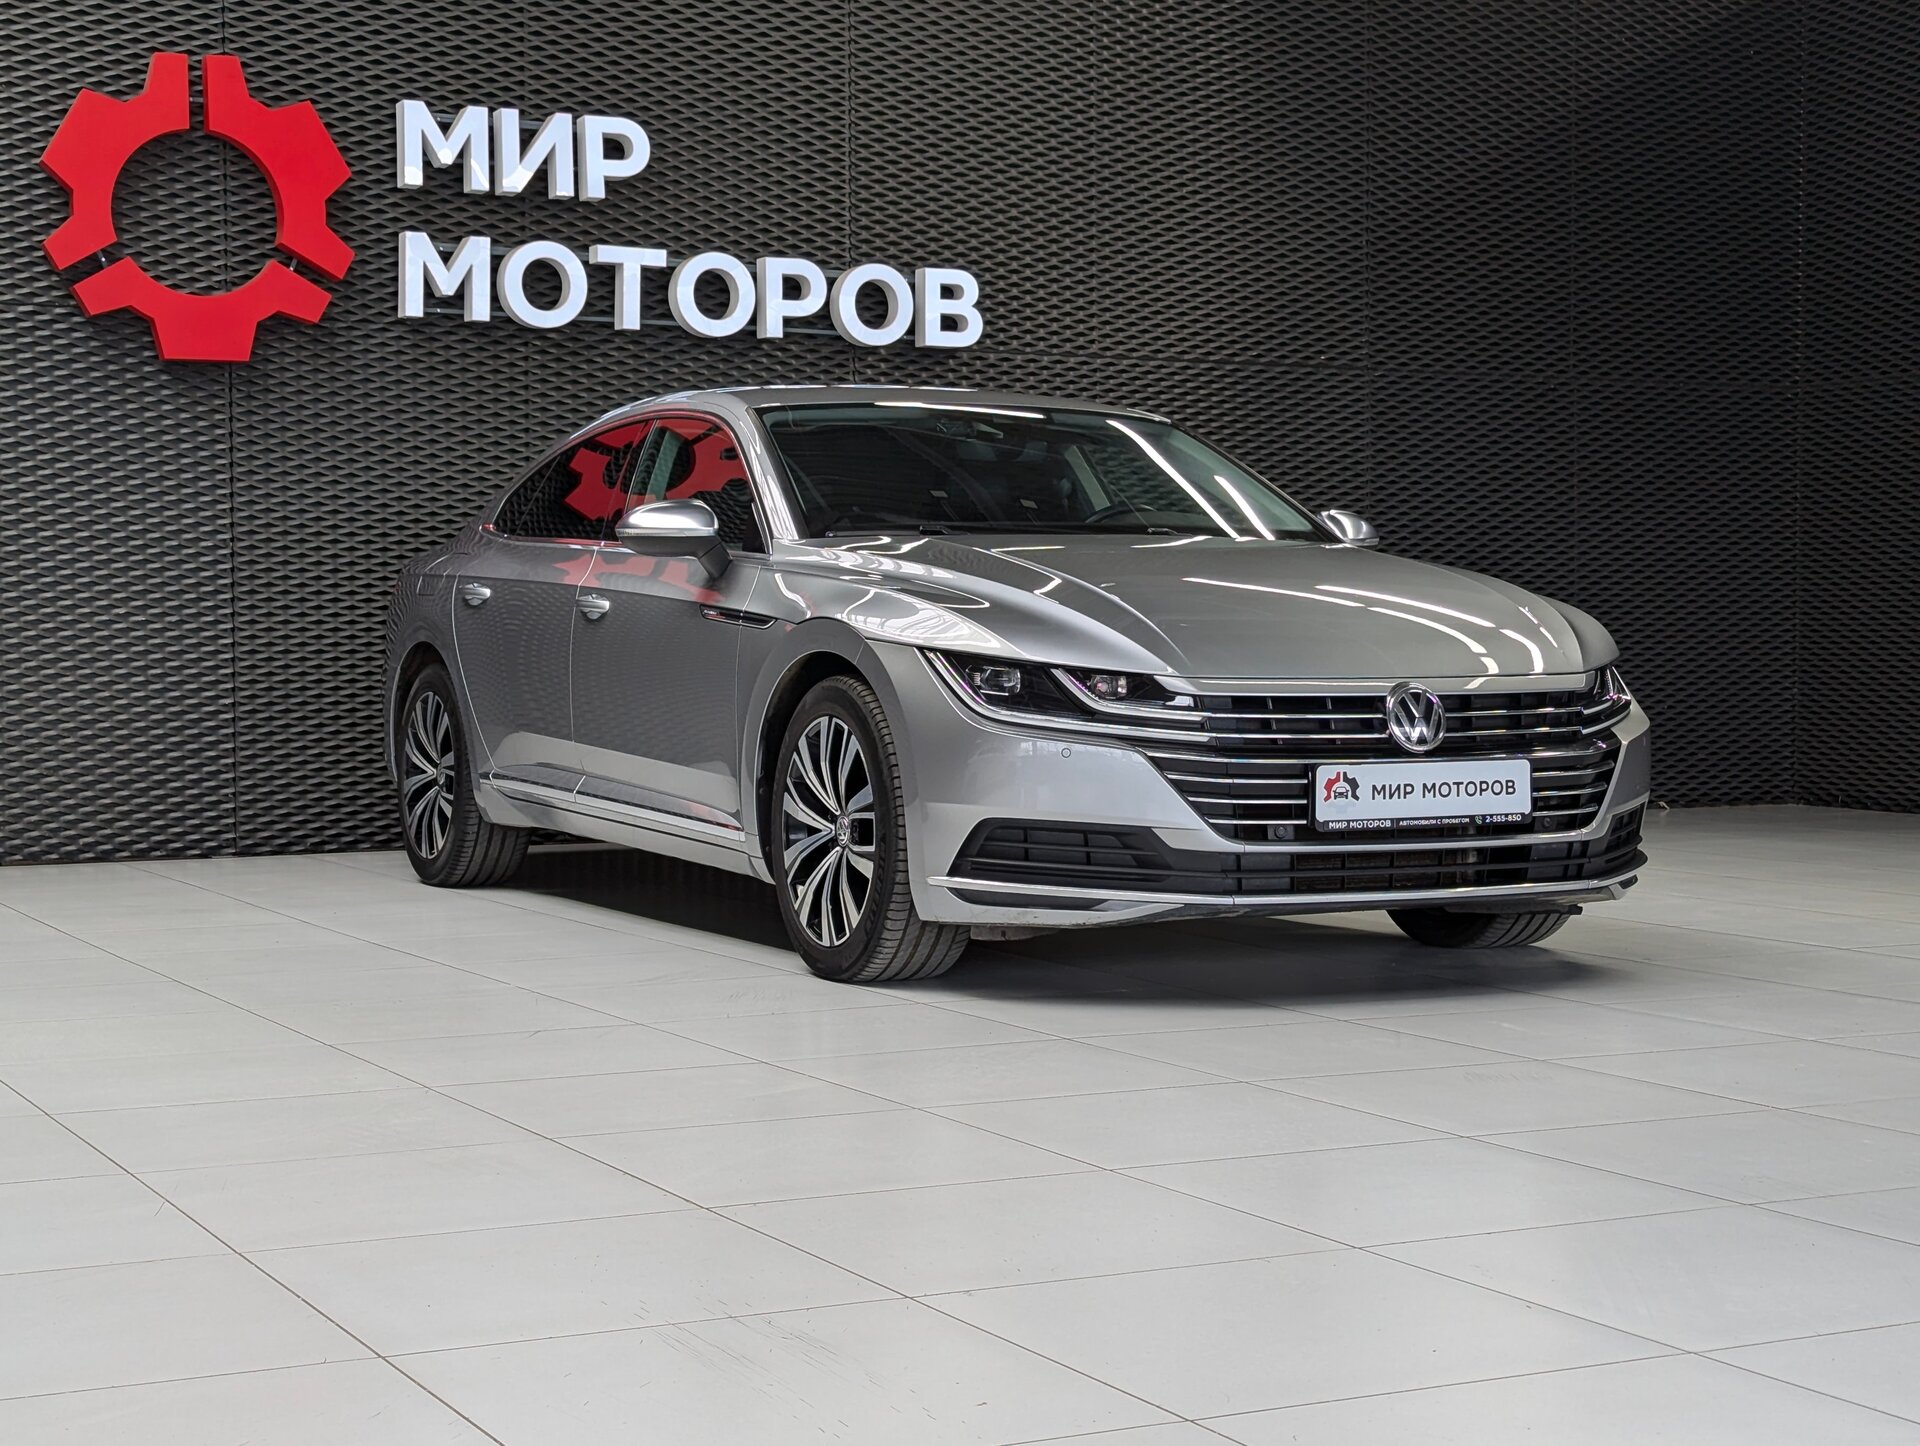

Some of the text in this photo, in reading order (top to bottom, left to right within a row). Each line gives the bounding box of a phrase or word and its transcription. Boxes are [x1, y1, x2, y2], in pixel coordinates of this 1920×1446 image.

[396, 99, 651, 201] МИР
[397, 231, 984, 348] МОТОРОВ
[1371, 779, 1517, 801] МИР МОТОРОВ
[1328, 821, 1348, 829] МИР
[1349, 819, 1391, 829] МОТОРОВ
[1485, 814, 1522, 823] 2-555-850
